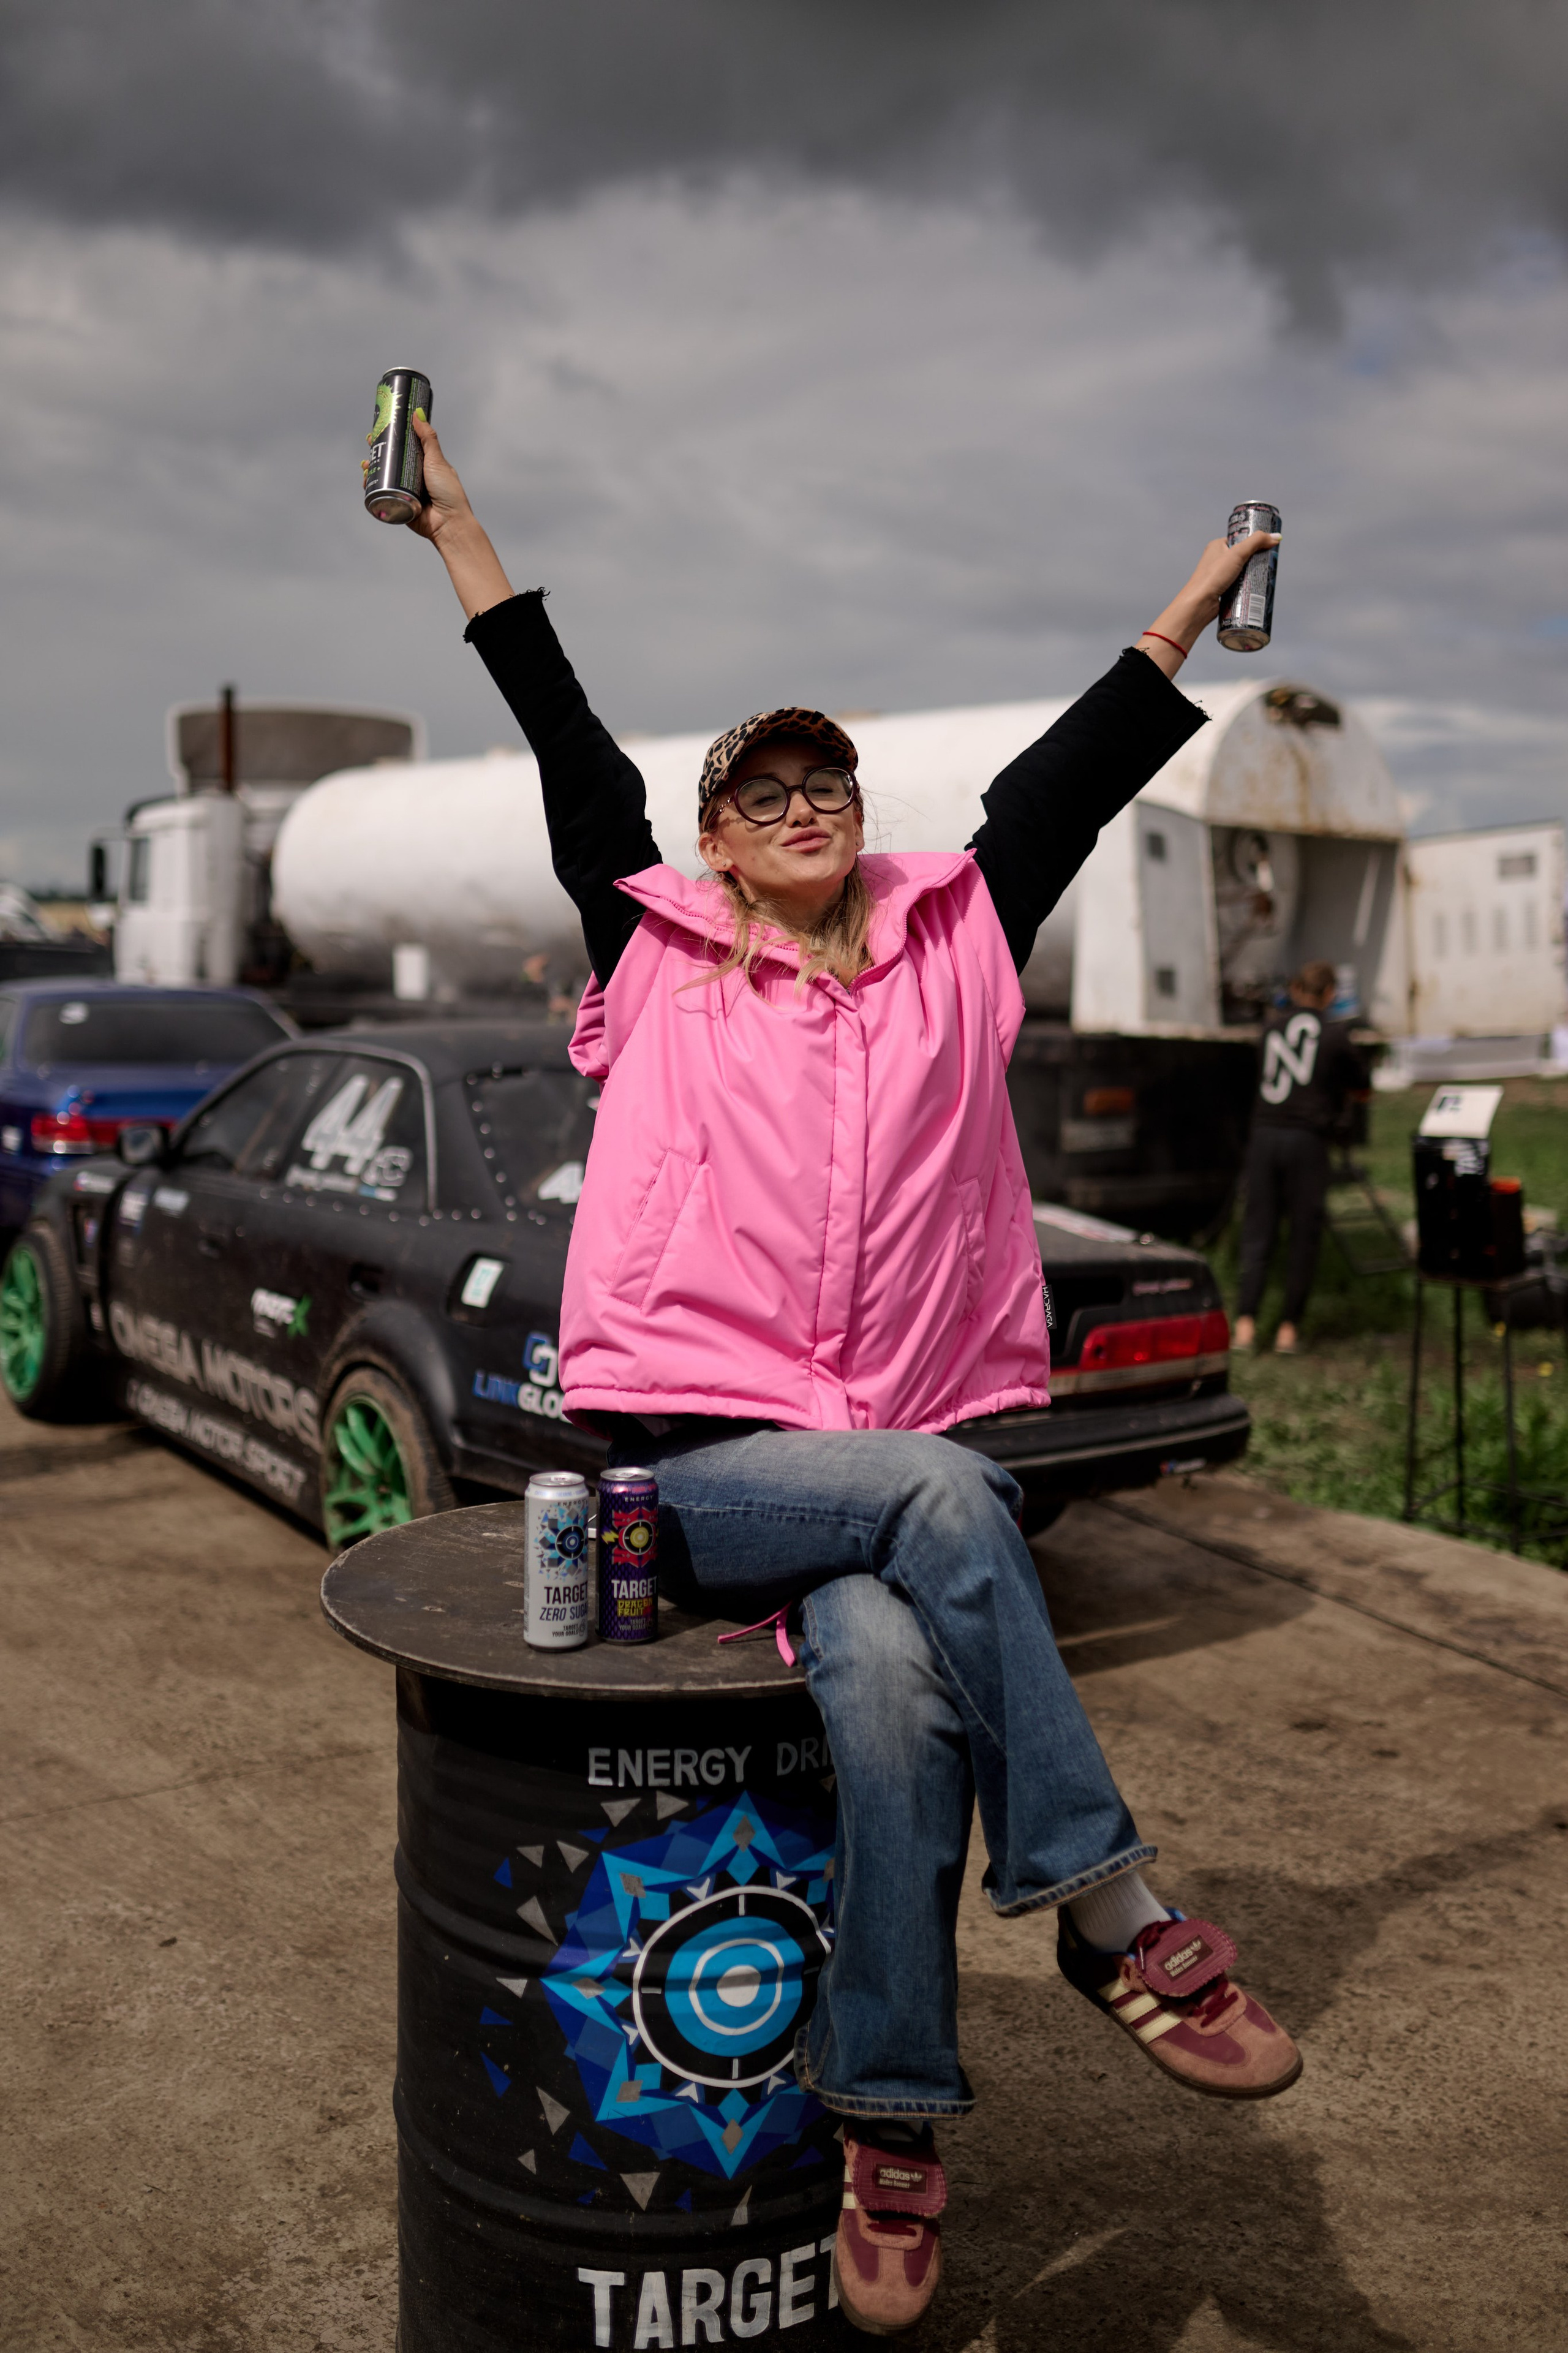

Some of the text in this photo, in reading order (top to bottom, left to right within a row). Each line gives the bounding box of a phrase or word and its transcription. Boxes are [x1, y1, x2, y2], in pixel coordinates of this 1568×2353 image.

[544, 1581, 588, 1604] TARGET
[611, 1576, 657, 1599] TARGET
[540, 1607, 567, 1622] ZERO
[617, 1607, 644, 1617] FRUIT
[588, 1733, 834, 1788] ENERGY DRI
[1165, 1947, 1193, 1970] adidas
[880, 2168, 910, 2180] adidas
